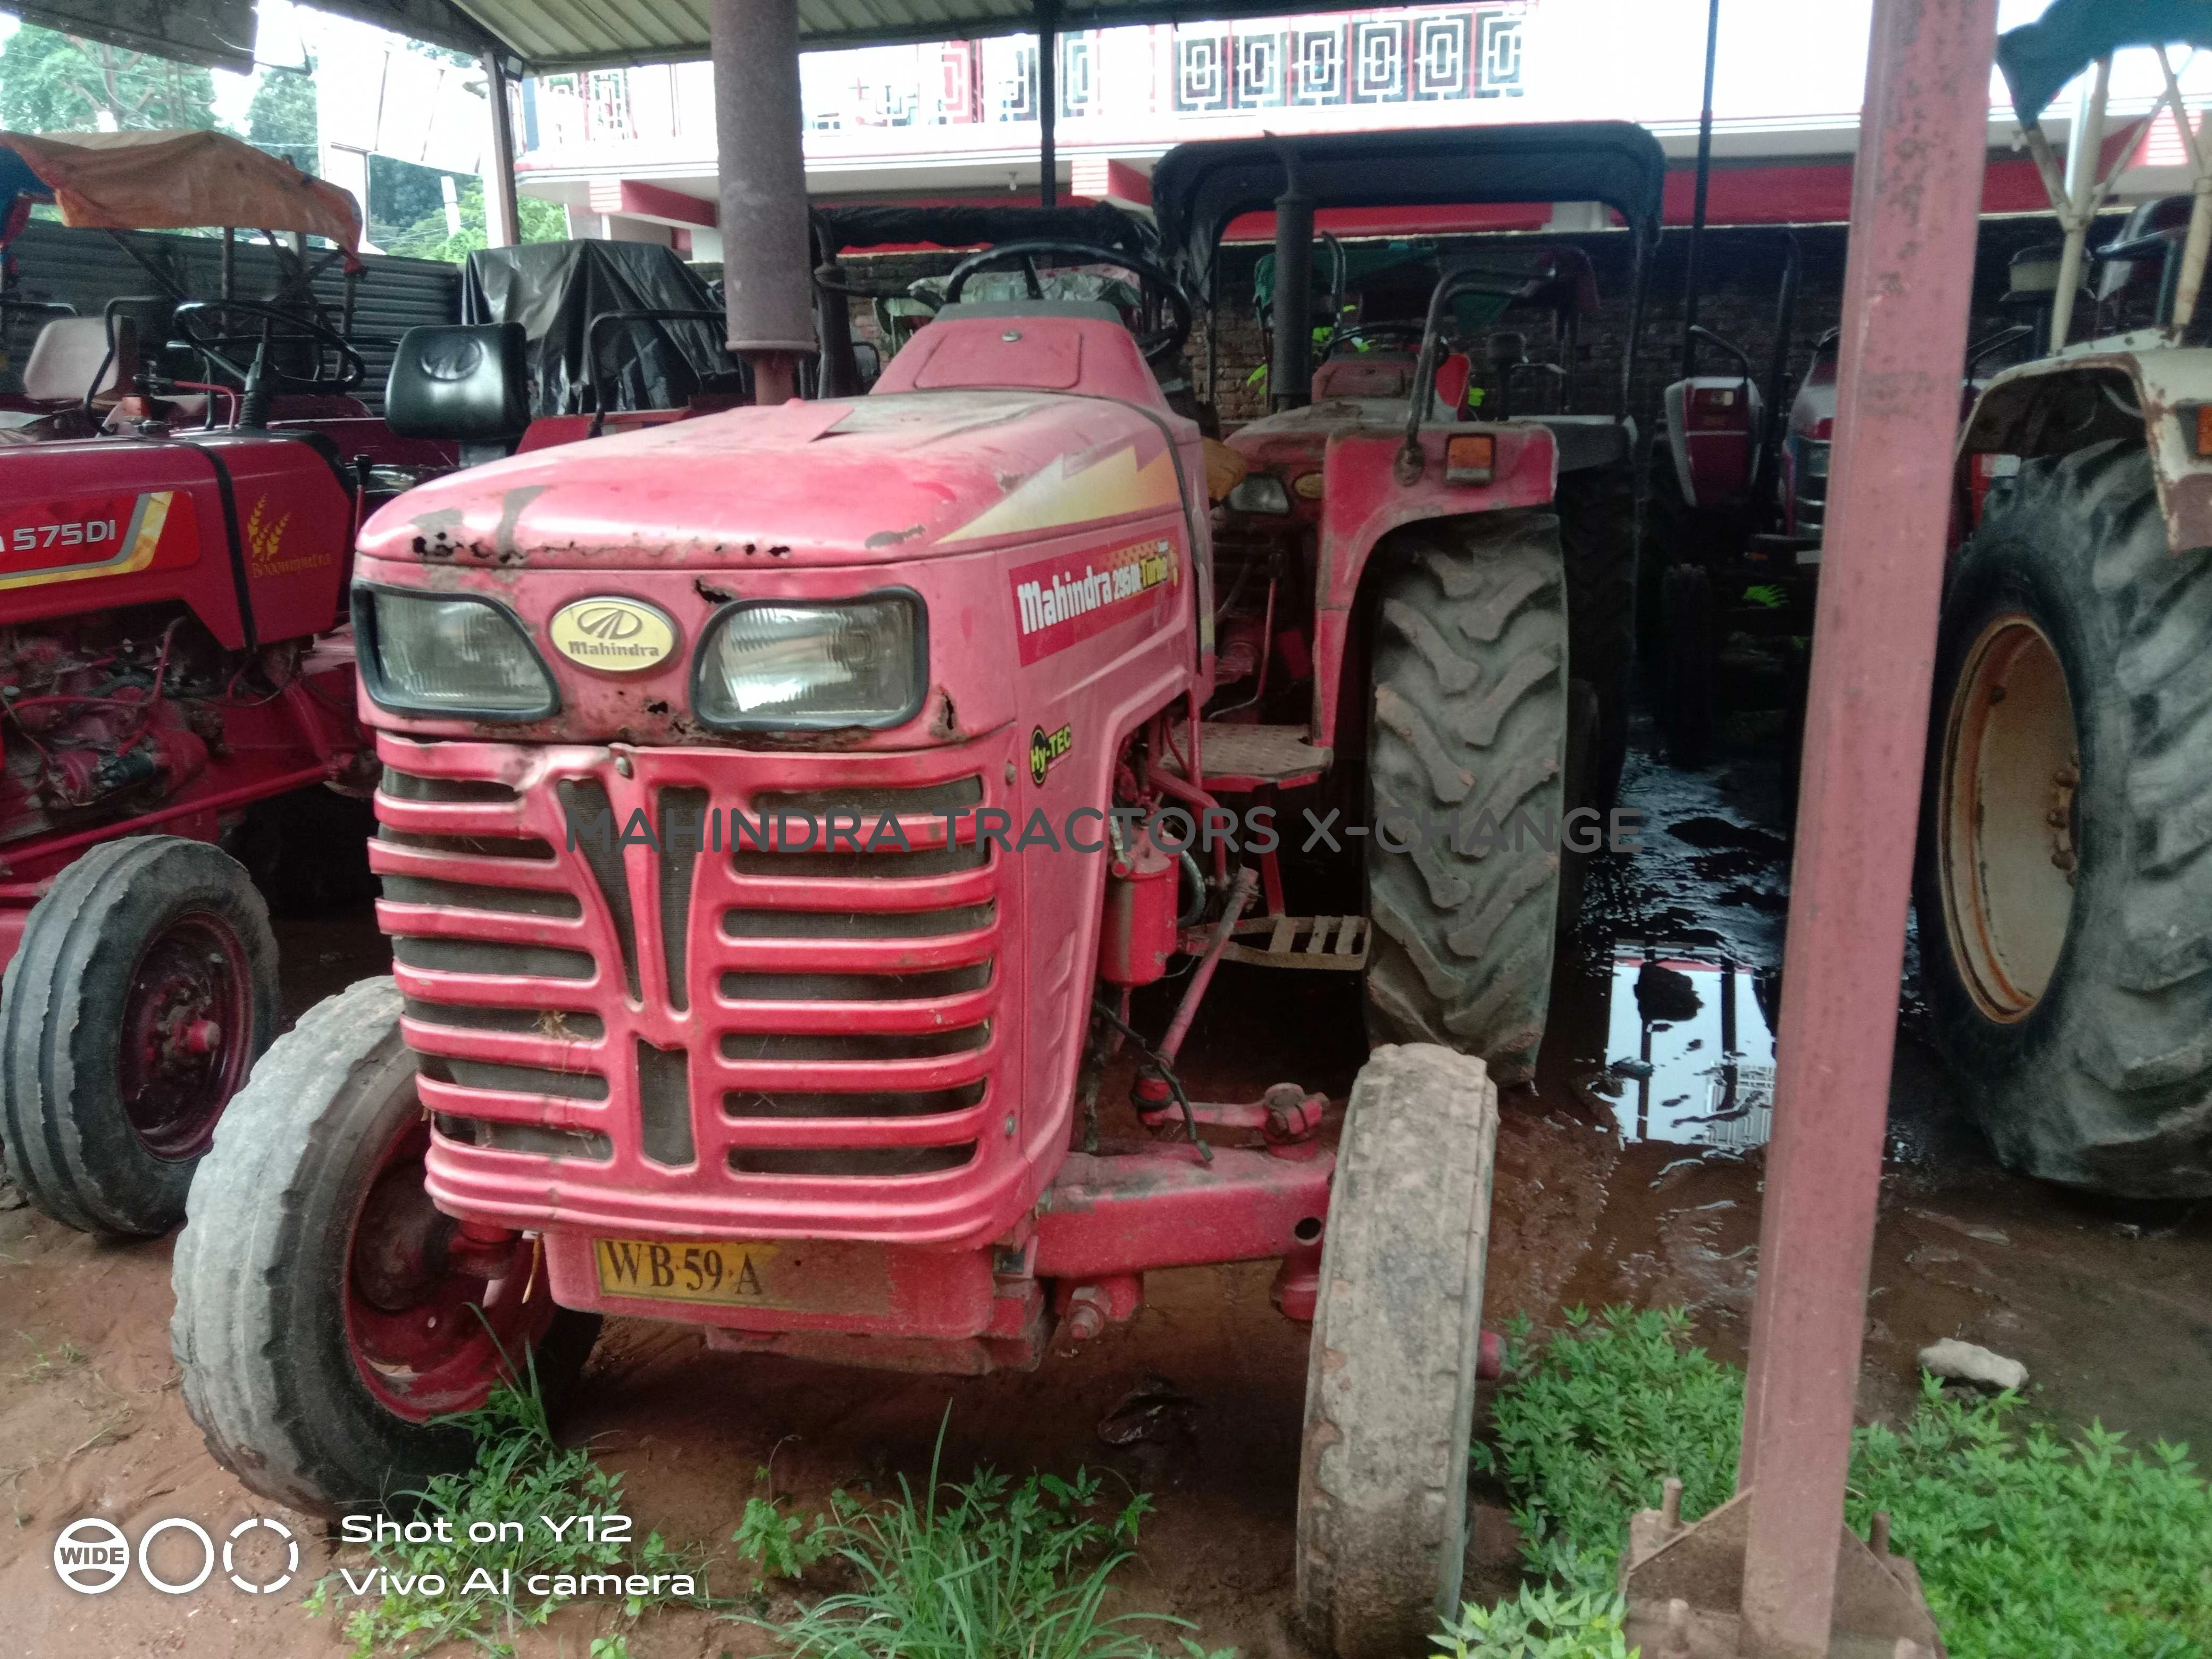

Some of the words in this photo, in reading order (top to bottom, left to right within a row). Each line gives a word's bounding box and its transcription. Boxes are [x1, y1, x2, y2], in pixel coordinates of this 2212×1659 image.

[13, 520, 116, 551] 575DI
[1017, 565, 1112, 635] Mahindra
[568, 641, 659, 656] Mahindra
